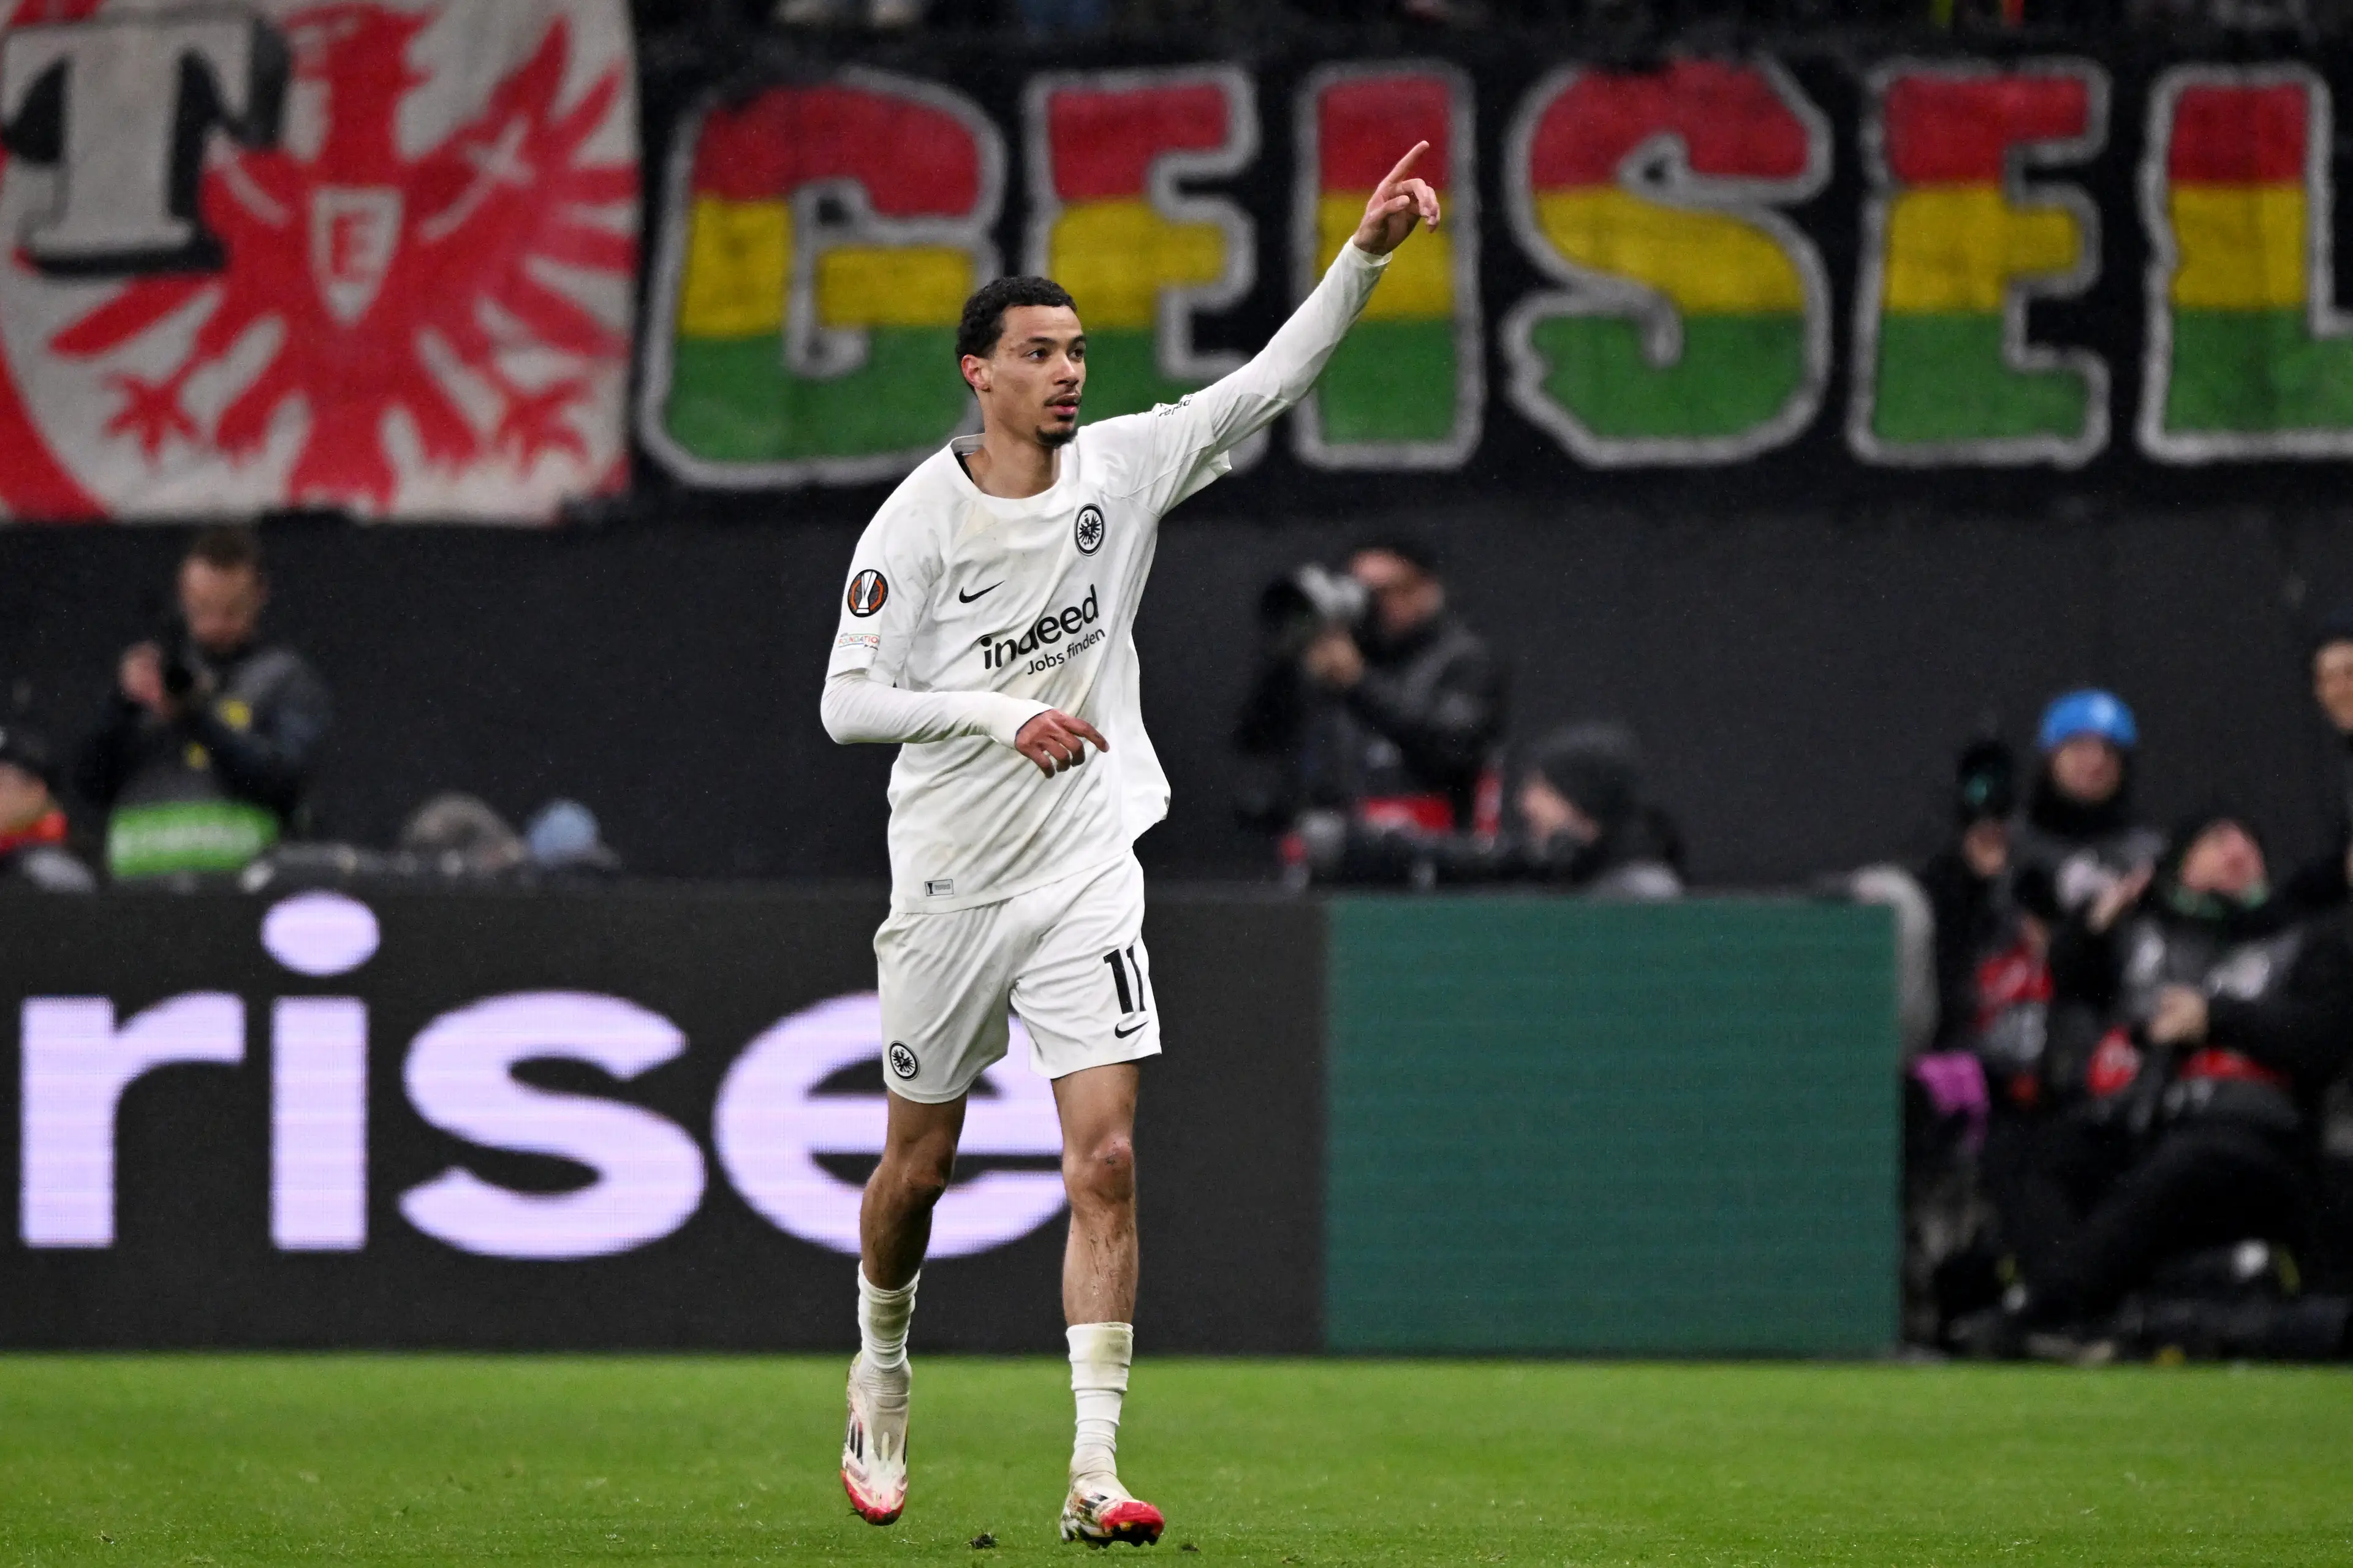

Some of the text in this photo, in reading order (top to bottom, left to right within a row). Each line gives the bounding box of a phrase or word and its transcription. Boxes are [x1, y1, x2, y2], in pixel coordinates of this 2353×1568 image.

[639, 52, 2353, 487] GEISEL
[980, 583, 1099, 670] indeed
[1028, 628, 1105, 675] Jobs finden
[1103, 945, 1147, 1014] 11
[20, 890, 1067, 1259] rise
